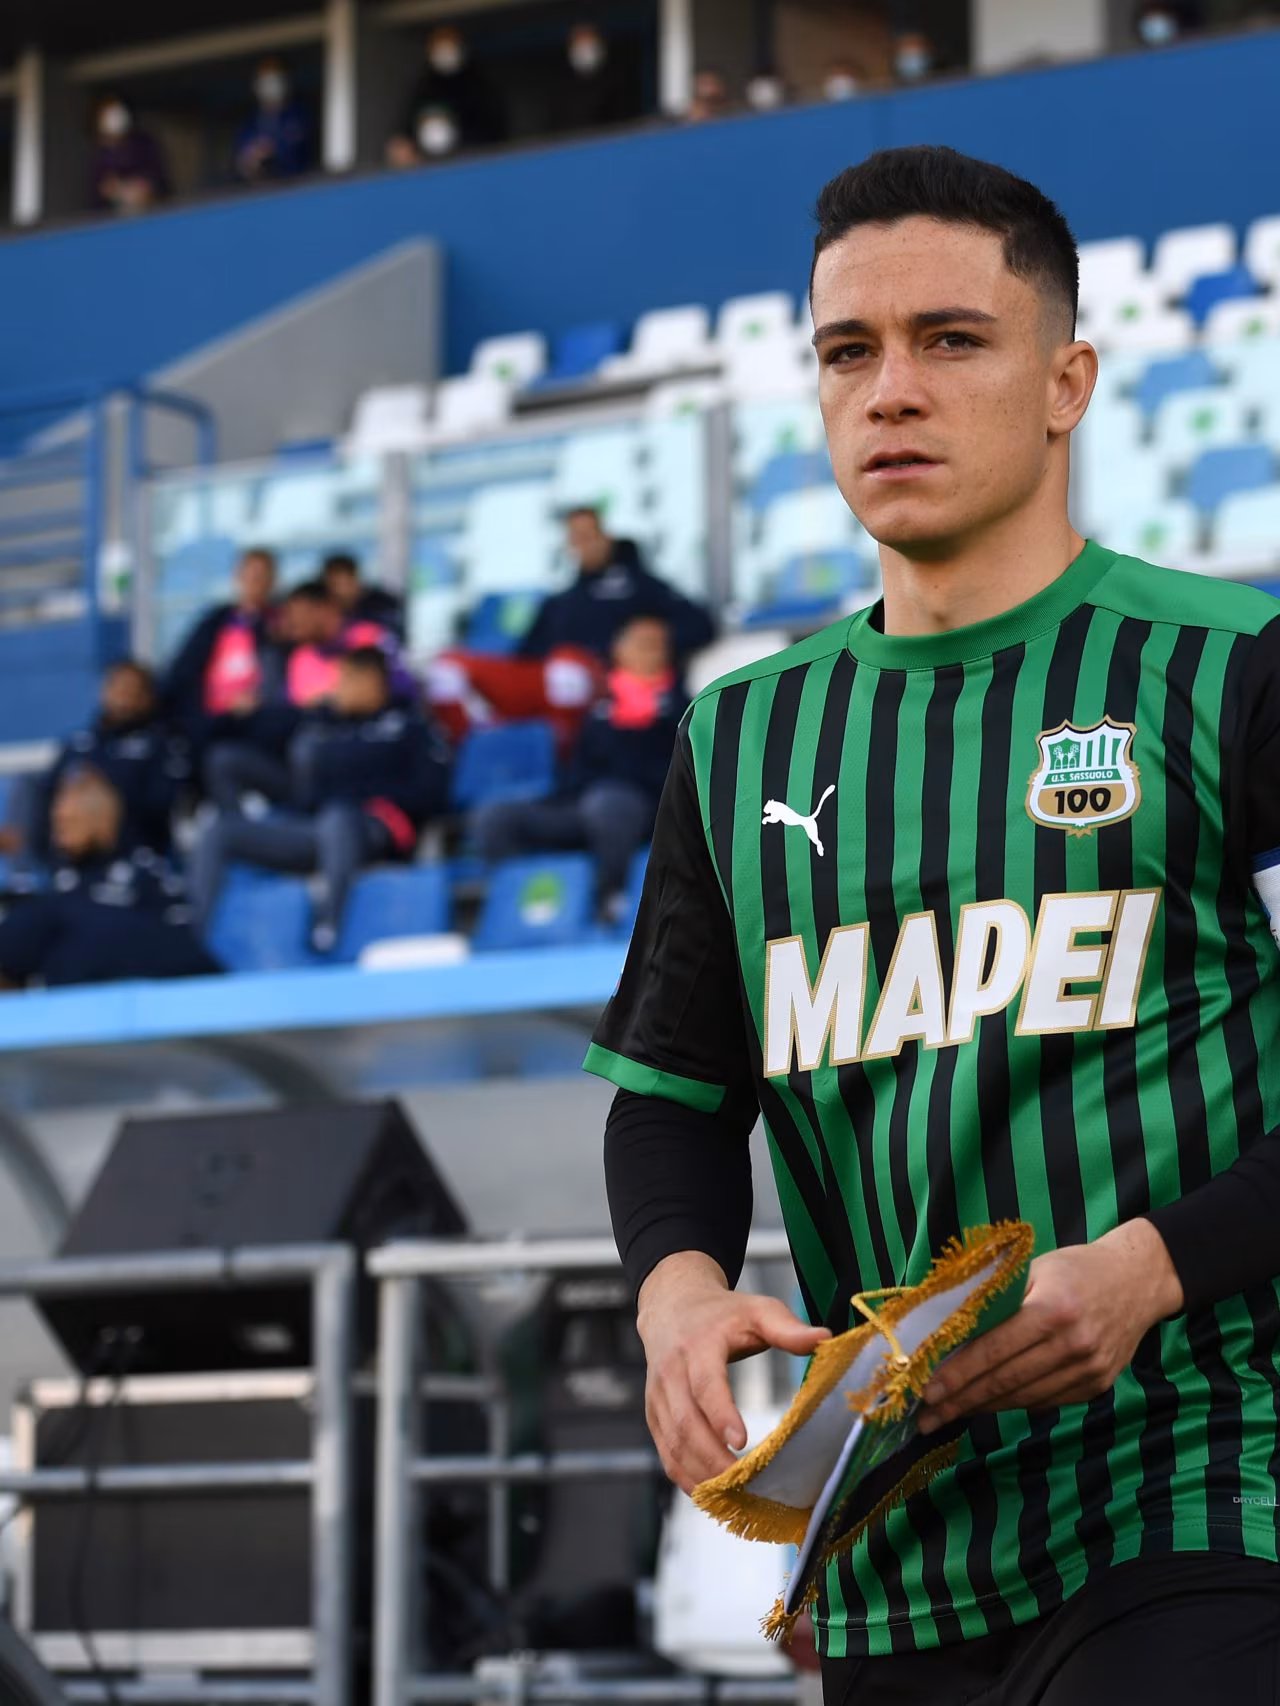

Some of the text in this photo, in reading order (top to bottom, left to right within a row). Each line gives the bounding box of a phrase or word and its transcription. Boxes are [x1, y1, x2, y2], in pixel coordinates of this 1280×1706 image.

[1069, 770, 1113, 781] SASSUOLO
[1054, 787, 1111, 815] 100
[763, 887, 1163, 1078] MAPEI
[1232, 1495, 1280, 1507] DRYCELL
